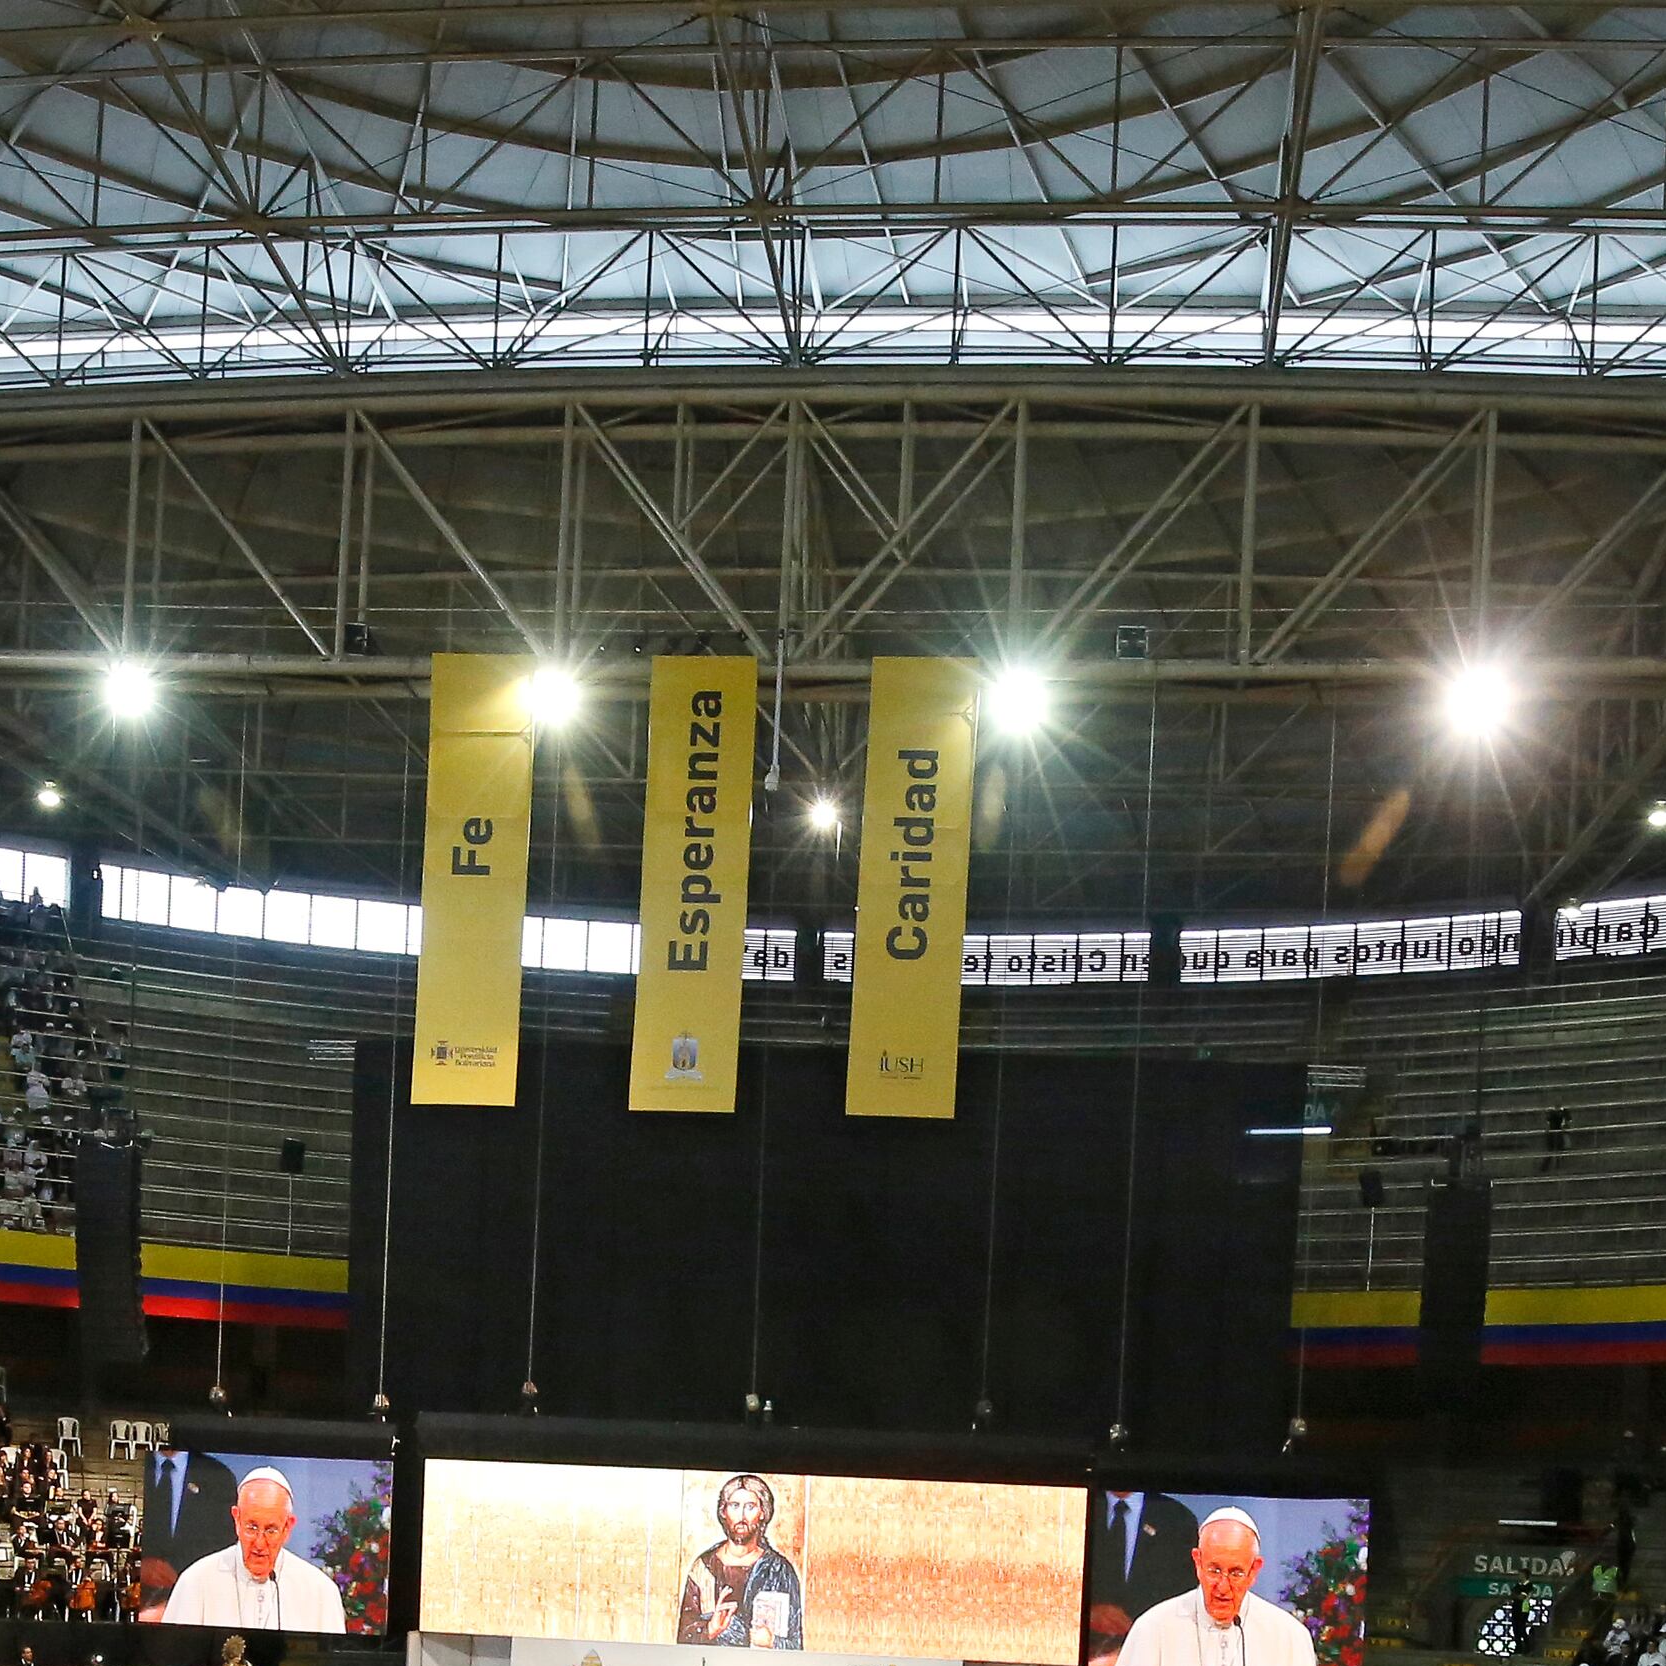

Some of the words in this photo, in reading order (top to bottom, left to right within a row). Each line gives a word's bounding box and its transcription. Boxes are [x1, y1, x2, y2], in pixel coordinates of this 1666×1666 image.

[452, 817, 493, 876] Fe
[668, 690, 722, 972] Esperanza
[886, 750, 939, 960] Caridad
[1474, 1555, 1565, 1576] SALIDA
